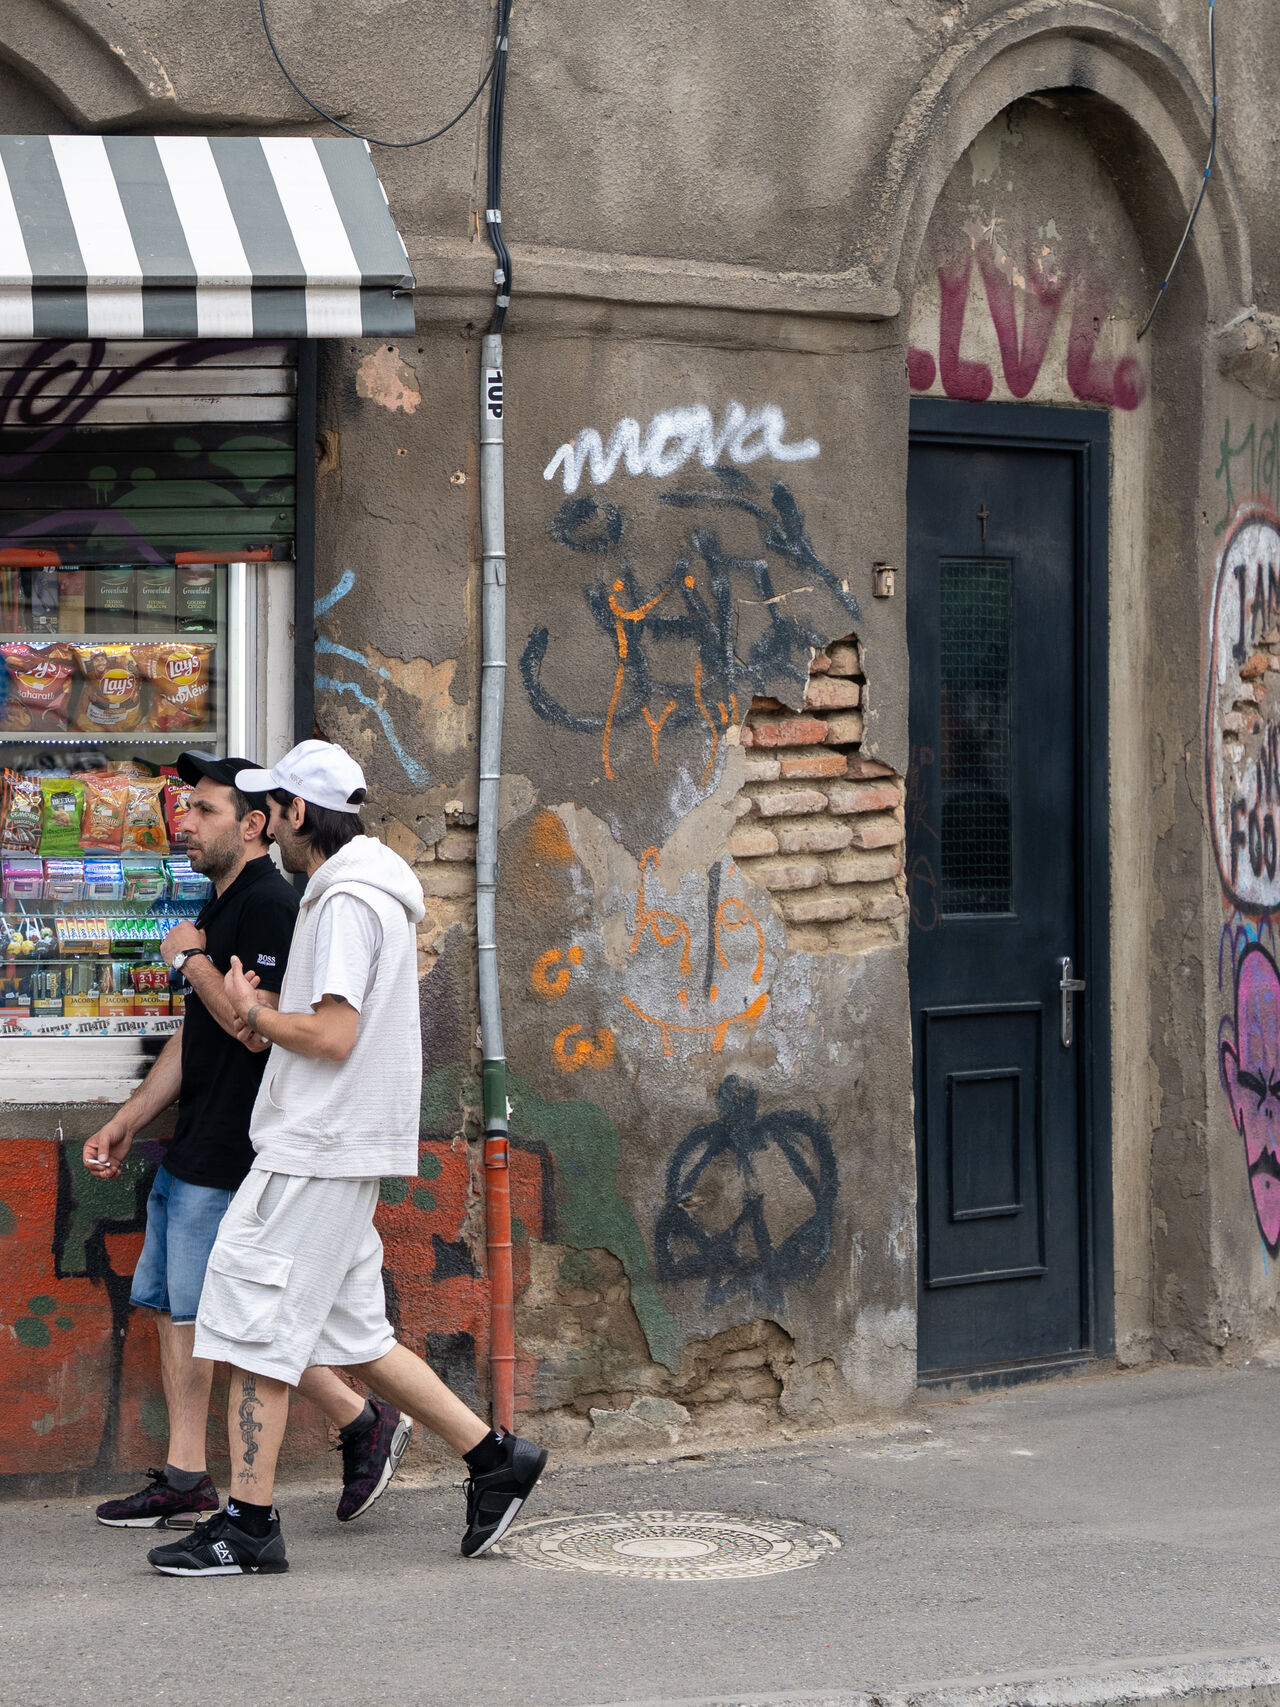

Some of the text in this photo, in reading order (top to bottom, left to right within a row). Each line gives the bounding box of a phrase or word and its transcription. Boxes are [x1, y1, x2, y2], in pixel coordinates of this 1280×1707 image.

[100, 586, 129, 594] Greenfield
[142, 586, 171, 594] Greenfield
[182, 586, 211, 595] Greenfield
[169, 655, 200, 678] Lay's
[103, 676, 133, 696] Lay's
[257, 953, 276, 962] BOSS
[212, 1540, 235, 1563] EA7
